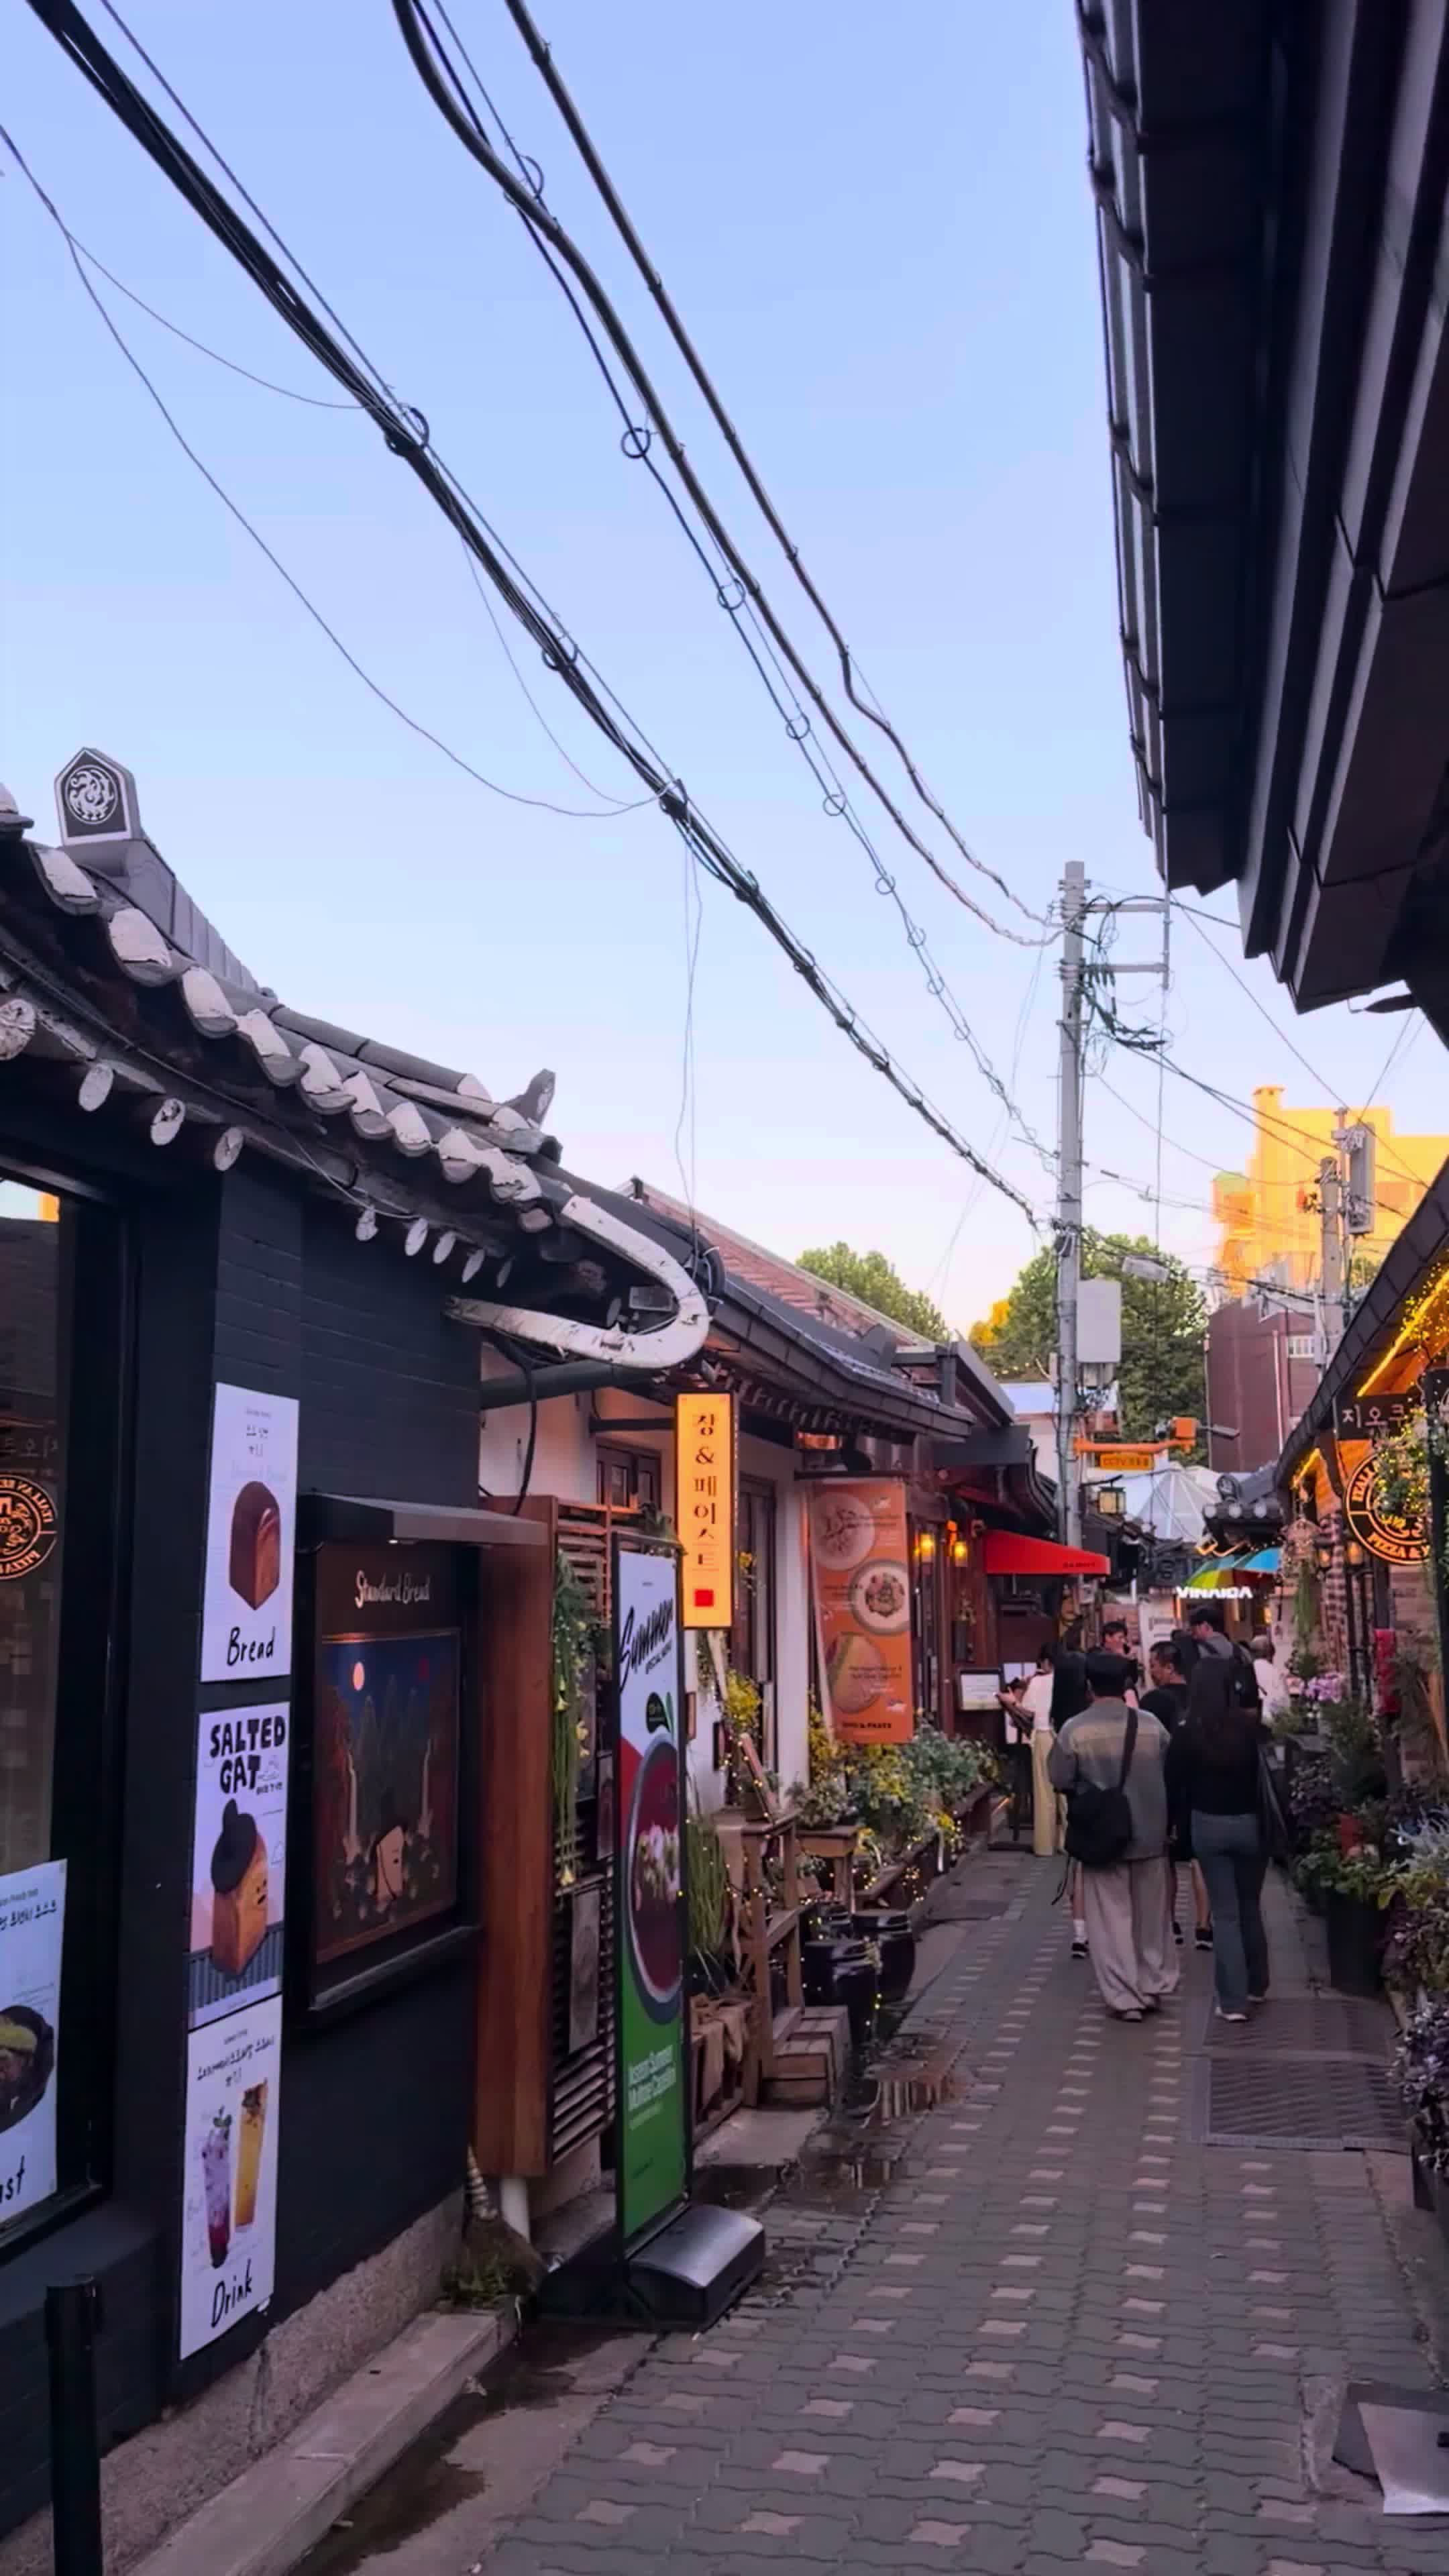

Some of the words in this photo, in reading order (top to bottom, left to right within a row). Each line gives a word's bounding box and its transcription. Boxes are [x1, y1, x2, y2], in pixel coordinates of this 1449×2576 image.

[695, 1445, 715, 1466] &
[1367, 1532, 1407, 1559] PIZZA
[354, 1570, 402, 1609] Standard
[403, 1572, 431, 1604] Bread
[227, 1625, 276, 1666] Bread
[209, 1715, 285, 1758] SALTED
[219, 1754, 261, 1794] GAT
[211, 2257, 252, 2328] Drink
